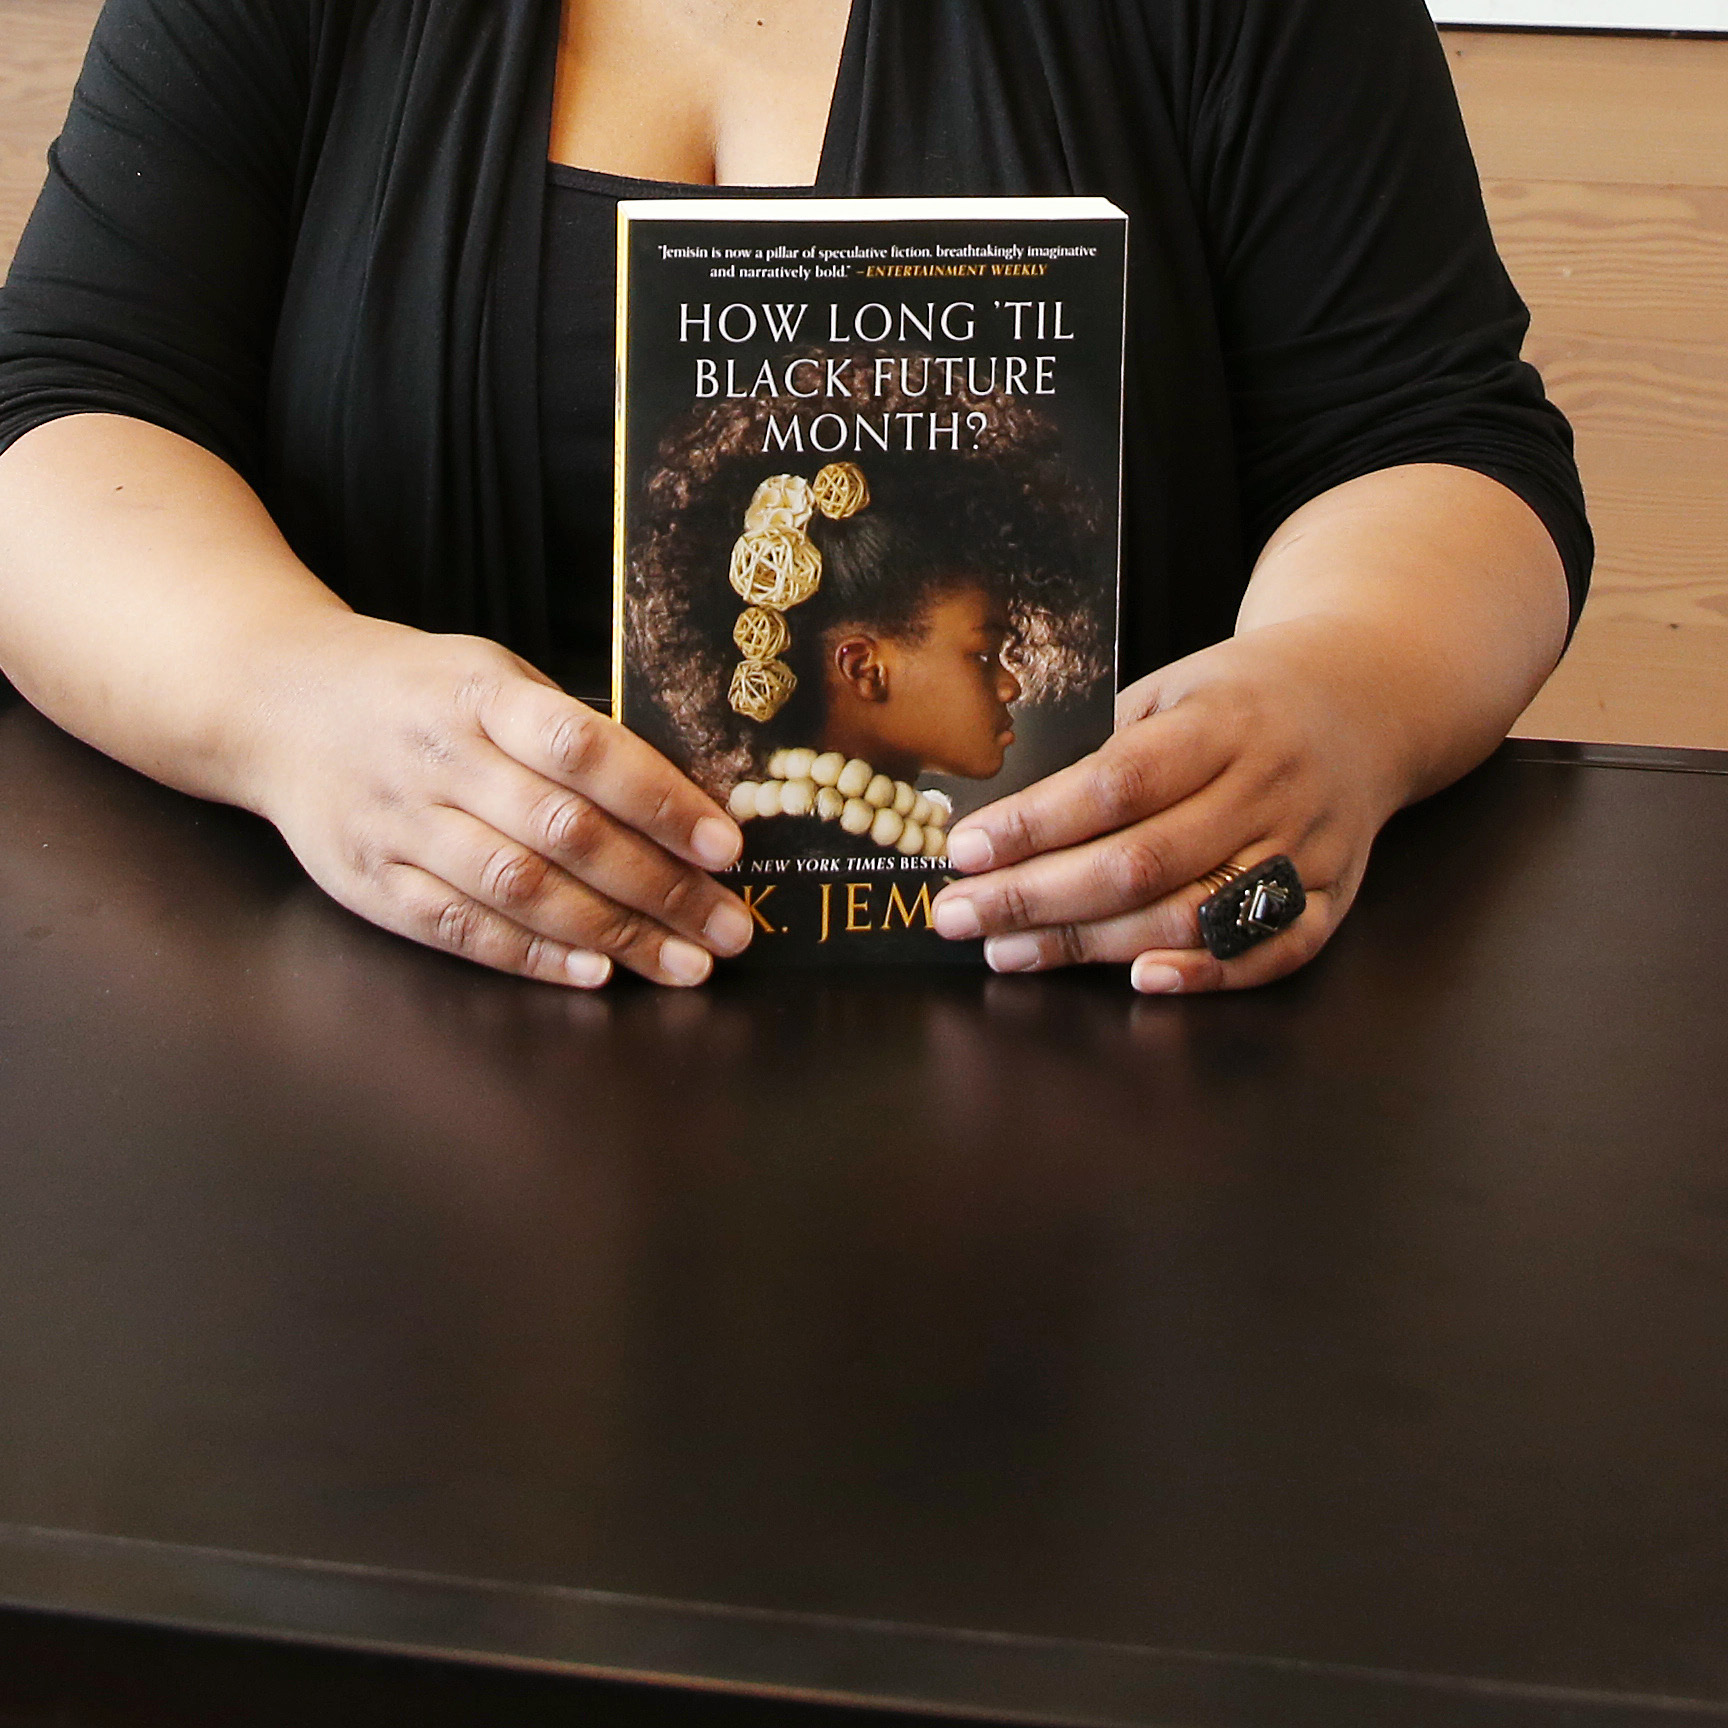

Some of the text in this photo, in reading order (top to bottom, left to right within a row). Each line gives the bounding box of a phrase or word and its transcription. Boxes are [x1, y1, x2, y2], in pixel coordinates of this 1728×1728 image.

[712, 245, 721, 259] is
[725, 249, 752, 259] now
[755, 249, 763, 259] a
[766, 245, 799, 261] pillar
[803, 245, 815, 259] of
[819, 245, 887, 261] speculative
[936, 244, 1024, 261] breathtakingly
[1028, 245, 1096, 260] imaginative
[710, 265, 735, 278] and
[739, 265, 811, 280] narratively
[992, 264, 1047, 276] WEEKLY
[679, 301, 1073, 342] HOW LONG 'TIL
[695, 356, 1056, 398] BLACK FUTURE
[762, 412, 988, 452] MONTH?
[724, 861, 743, 872] Y
[751, 859, 790, 872] NEW
[796, 858, 840, 872] YORK
[847, 857, 895, 871] TIMES
